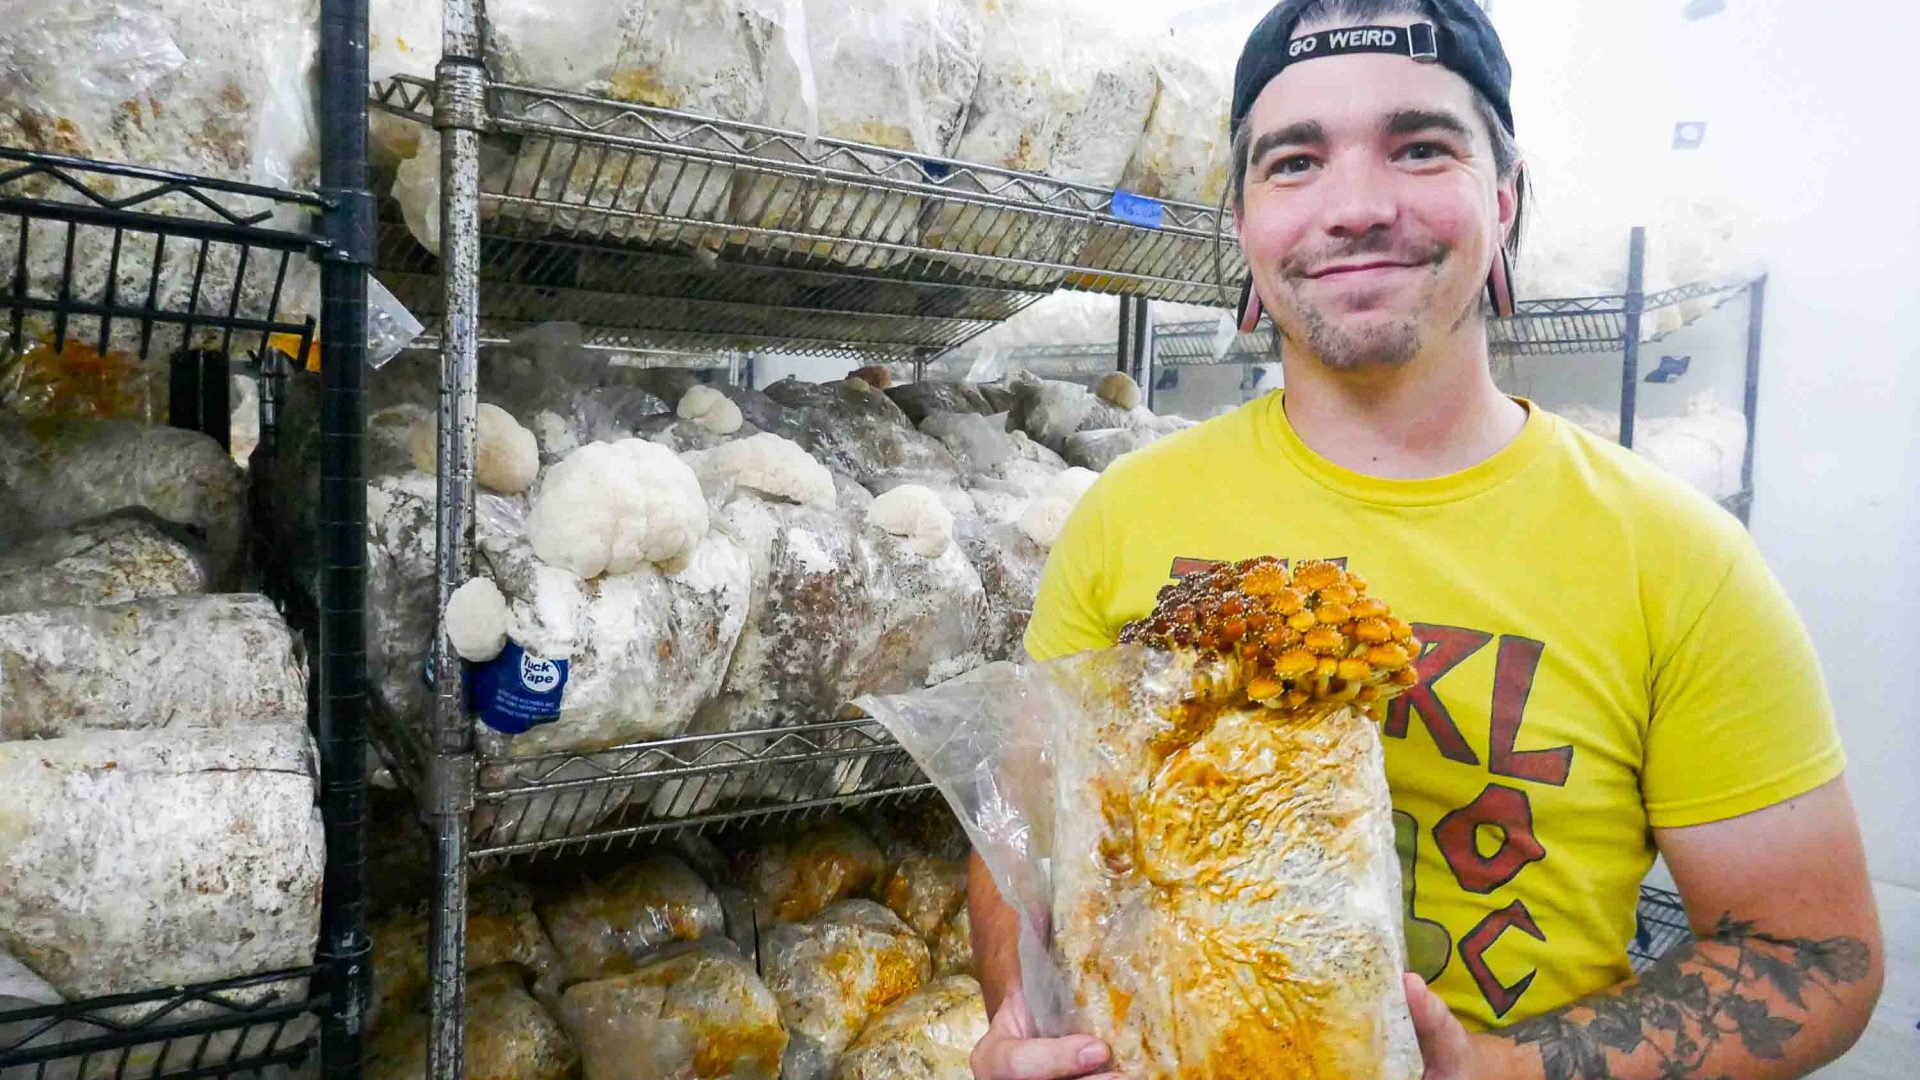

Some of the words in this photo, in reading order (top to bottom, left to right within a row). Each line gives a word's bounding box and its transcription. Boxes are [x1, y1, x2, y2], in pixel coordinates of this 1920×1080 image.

[1289, 37, 1317, 57] GO
[1329, 30, 1396, 49] WEIRD
[524, 655, 551, 672] Tuck
[523, 668, 554, 684] Tape
